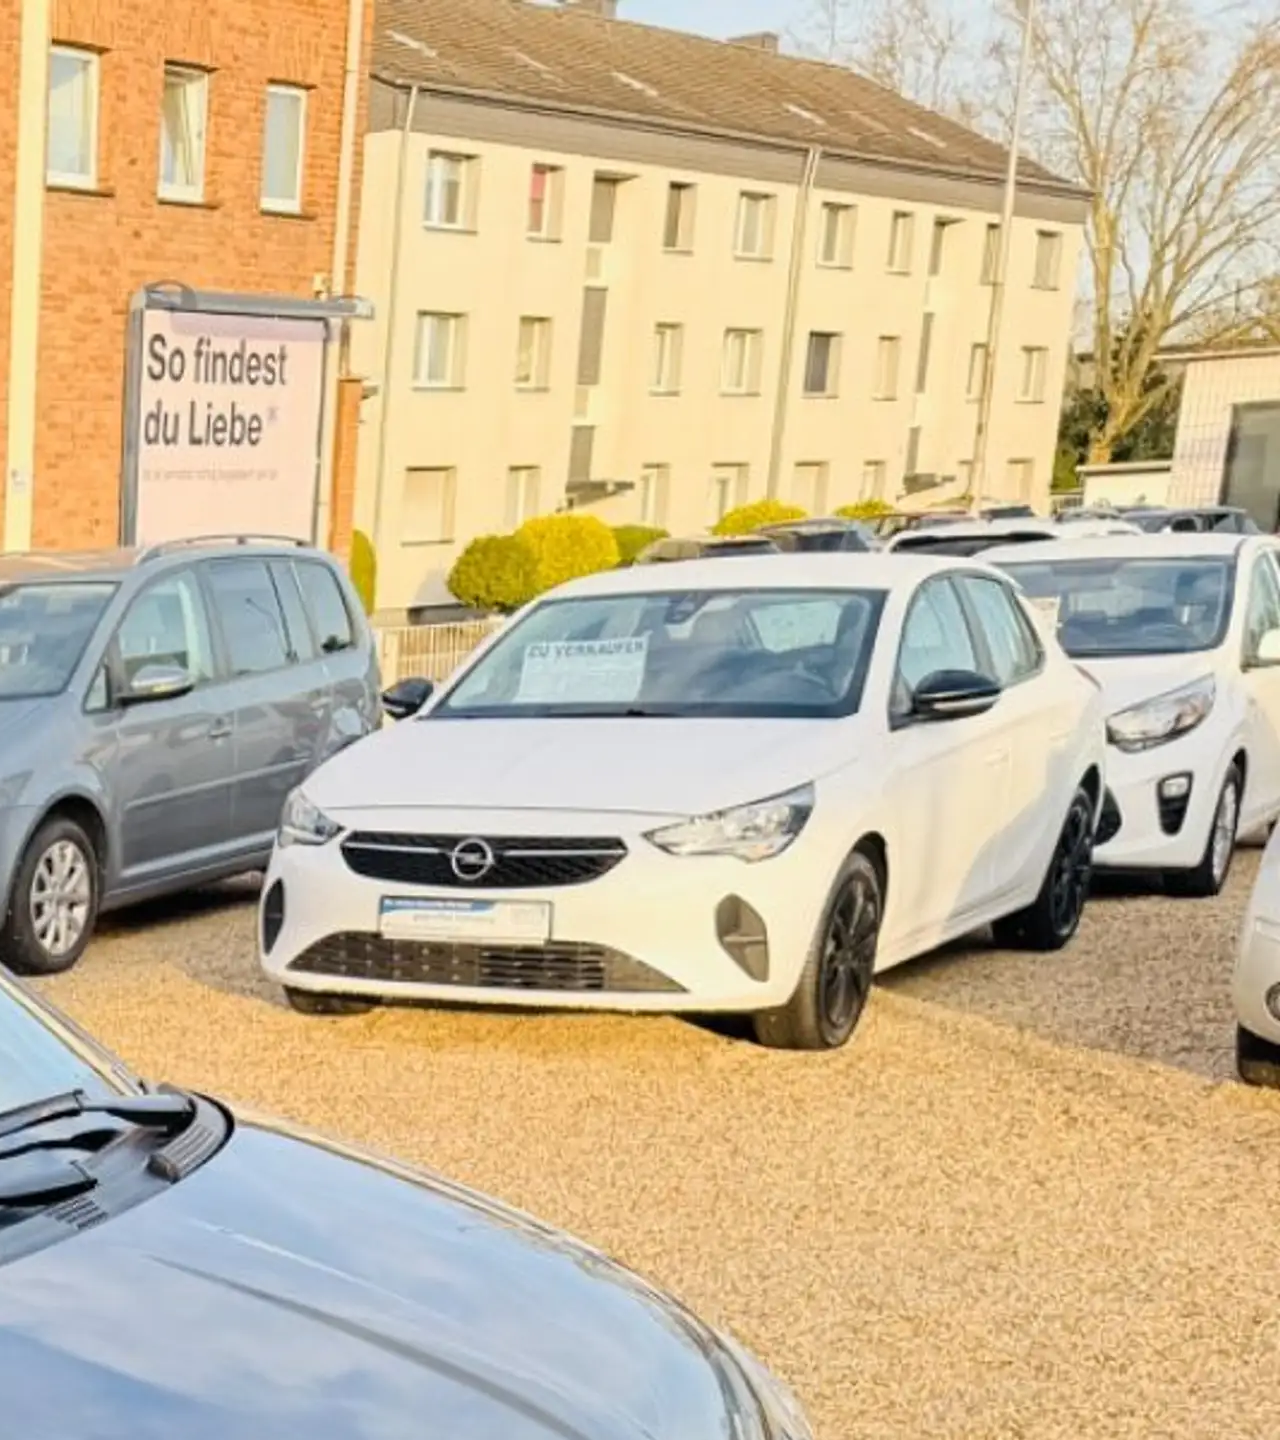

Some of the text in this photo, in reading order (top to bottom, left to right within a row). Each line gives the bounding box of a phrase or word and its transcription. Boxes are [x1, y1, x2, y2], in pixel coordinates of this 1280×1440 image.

[147, 333, 288, 386] So findest
[144, 400, 263, 447] du Liebe
